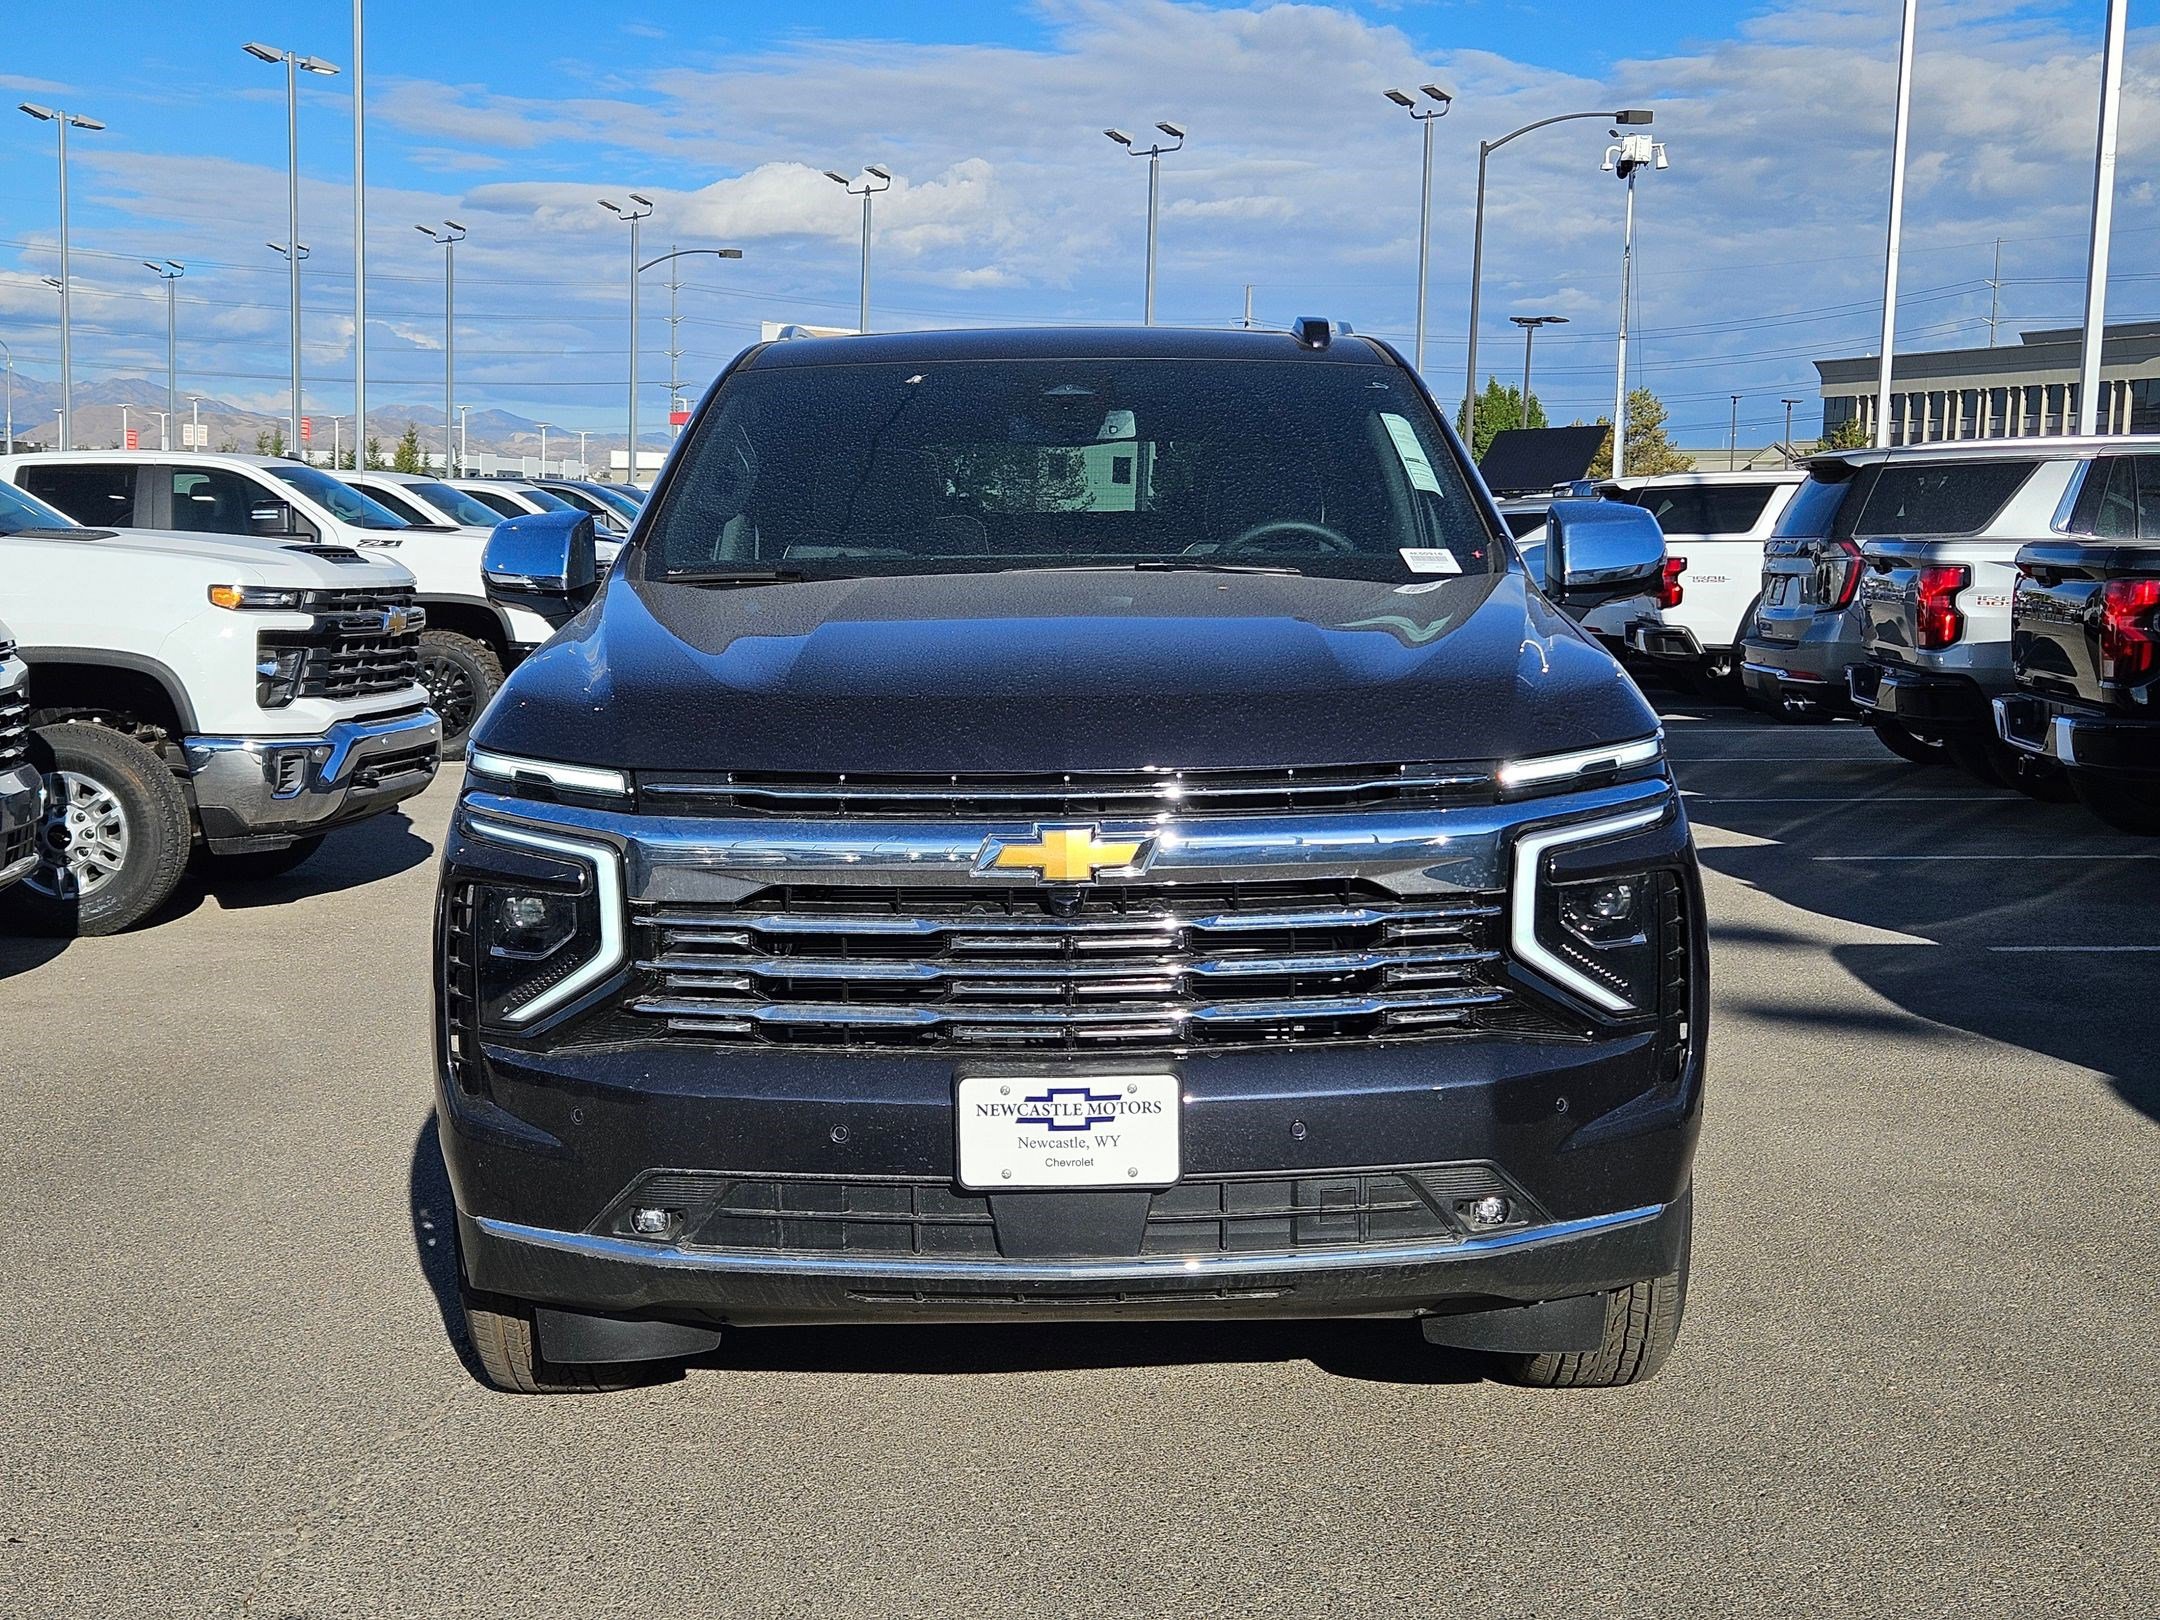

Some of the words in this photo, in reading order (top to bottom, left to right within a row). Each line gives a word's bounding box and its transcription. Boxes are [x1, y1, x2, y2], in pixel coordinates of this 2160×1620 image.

[976, 1102, 1083, 1117] NEWCASTLE
[1087, 1100, 1162, 1116] MOTORS
[1018, 1136, 1090, 1150] Newcastle,
[1094, 1134, 1121, 1148] WY
[1045, 1157, 1094, 1168] Chevrolet
